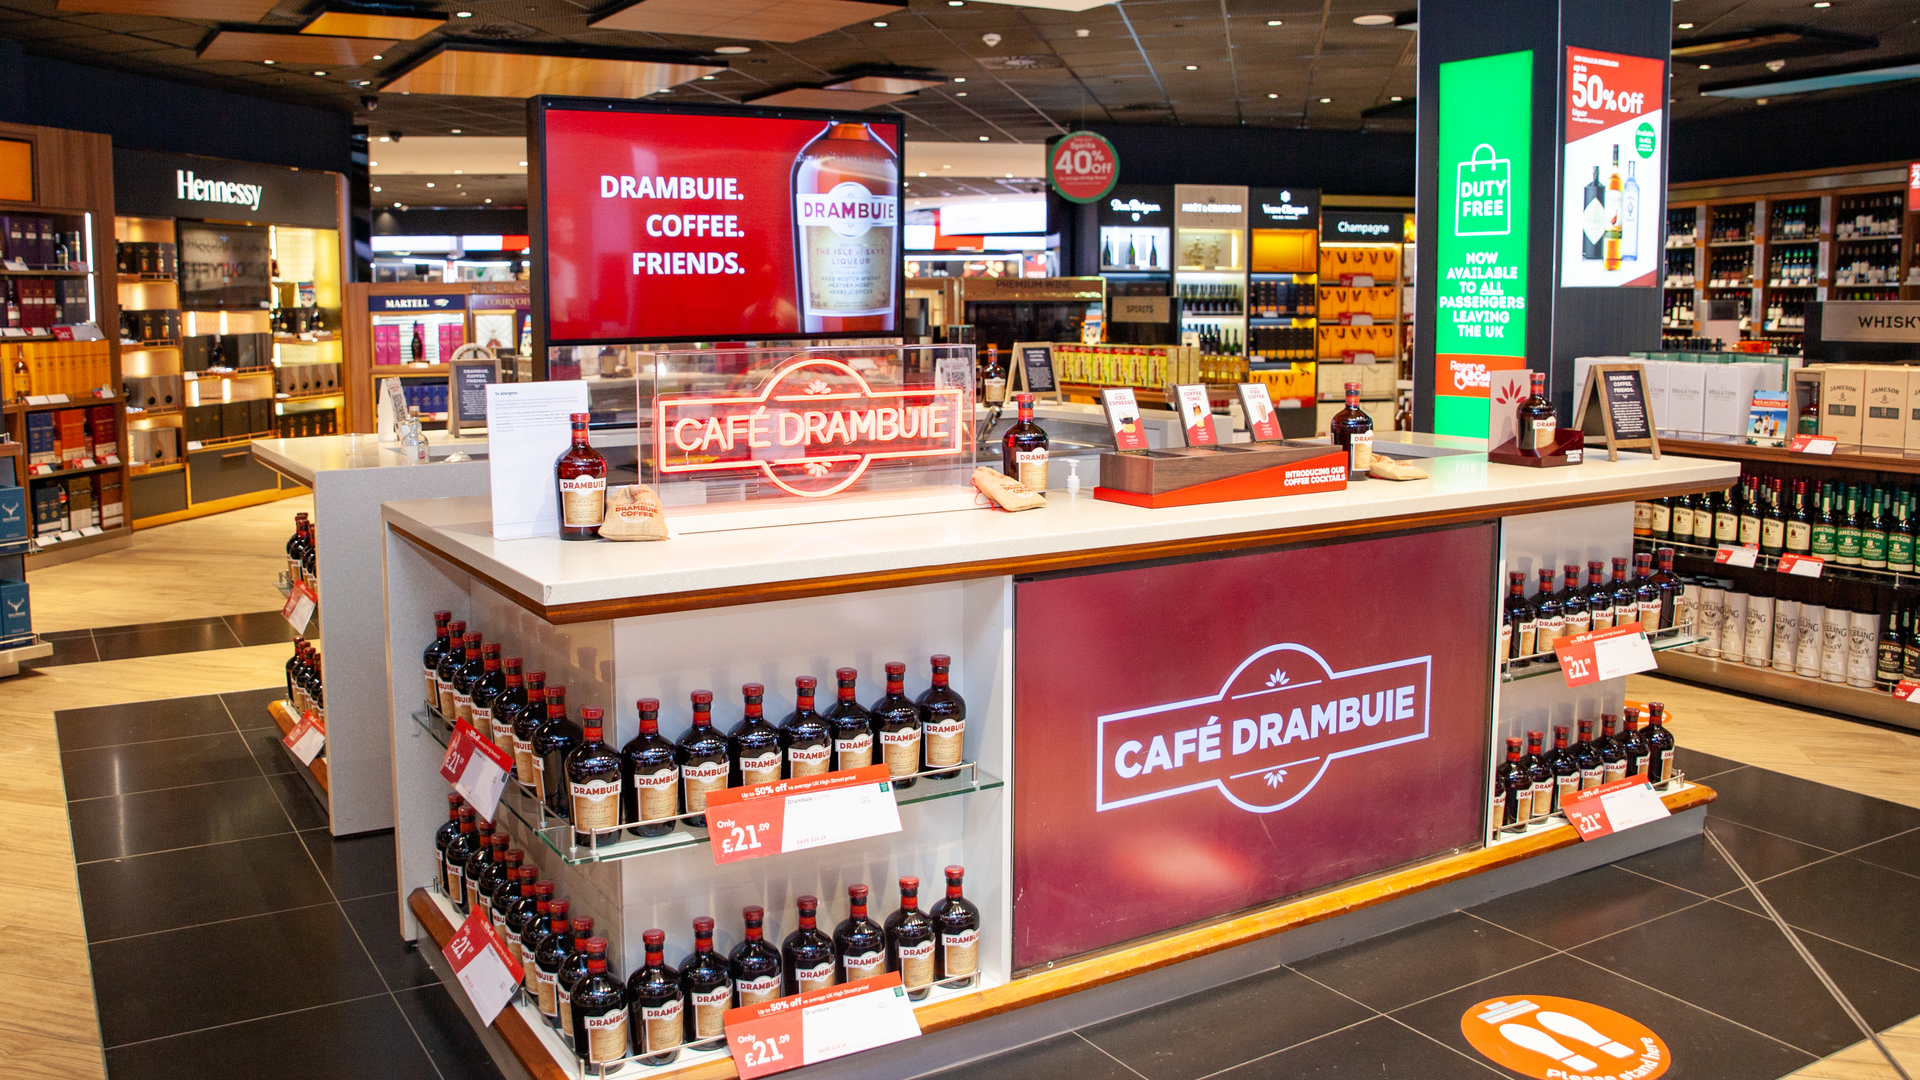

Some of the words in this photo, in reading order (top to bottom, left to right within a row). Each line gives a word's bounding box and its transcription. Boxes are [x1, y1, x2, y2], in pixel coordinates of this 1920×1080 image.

[1572, 72, 1617, 111] 50%
[1618, 91, 1644, 114] Off
[176, 169, 262, 211] Hennessy
[600, 175, 744, 200] DRAMBUIE.
[1461, 179, 1508, 198] DUTY
[804, 202, 894, 219] DRAMBUIE
[1462, 200, 1504, 217] FREE
[646, 214, 745, 238] COFFEE.
[1338, 222, 1390, 235] Champagne
[632, 252, 745, 275] FRIENDS.
[1466, 252, 1498, 264] NOW
[1446, 267, 1518, 279] AVAILABLE
[996, 280, 1042, 289] PREMIUM
[1045, 280, 1072, 289] WINE
[1459, 281, 1476, 293] TO
[1480, 281, 1504, 294] ALL
[386, 299, 430, 308] MARTELL
[1440, 296, 1525, 309] PASSENGERS
[1126, 305, 1154, 314] SPIRITS
[1452, 310, 1510, 323] LEAVING
[1458, 325, 1481, 337] THE
[1485, 325, 1504, 338] UK
[1450, 360, 1485, 372] Reserve
[1871, 386, 1900, 394] JAMESON
[674, 406, 771, 451] CAFÉ
[778, 405, 950, 446] DRAMBUIE
[1285, 467, 1330, 478] INTRODUCING
[1331, 466, 1345, 474] OUR
[563, 481, 604, 489] DRAMBUIE
[1284, 476, 1309, 486] COFFEE
[1311, 474, 1346, 484] COCKTAILS
[616, 505, 658, 514] DRAMBUIE
[926, 723, 964, 733] DRAMBUIE
[1114, 715, 1222, 779] CAFÉ
[1232, 685, 1415, 756] DRAMBUIE
[685, 766, 728, 777] DRAMBUIE
[574, 784, 619, 795] DRAMBUIE
[755, 785, 774, 796] 50%
[775, 783, 787, 792] off
[794, 783, 812, 791] average
[820, 779, 830, 787] High
[831, 776, 845, 784] Street
[787, 796, 813, 805] Drambuie
[717, 819, 736, 829] Only
[721, 822, 770, 854] £21.09
[770, 1000, 789, 1011] 50%
[790, 997, 802, 1007] off
[809, 995, 826, 1003] average
[833, 990, 844, 998] High
[844, 986, 858, 995] Street
[805, 1006, 830, 1016] Drambuie
[738, 1033, 756, 1044] Only
[744, 1034, 790, 1067] £21.09
